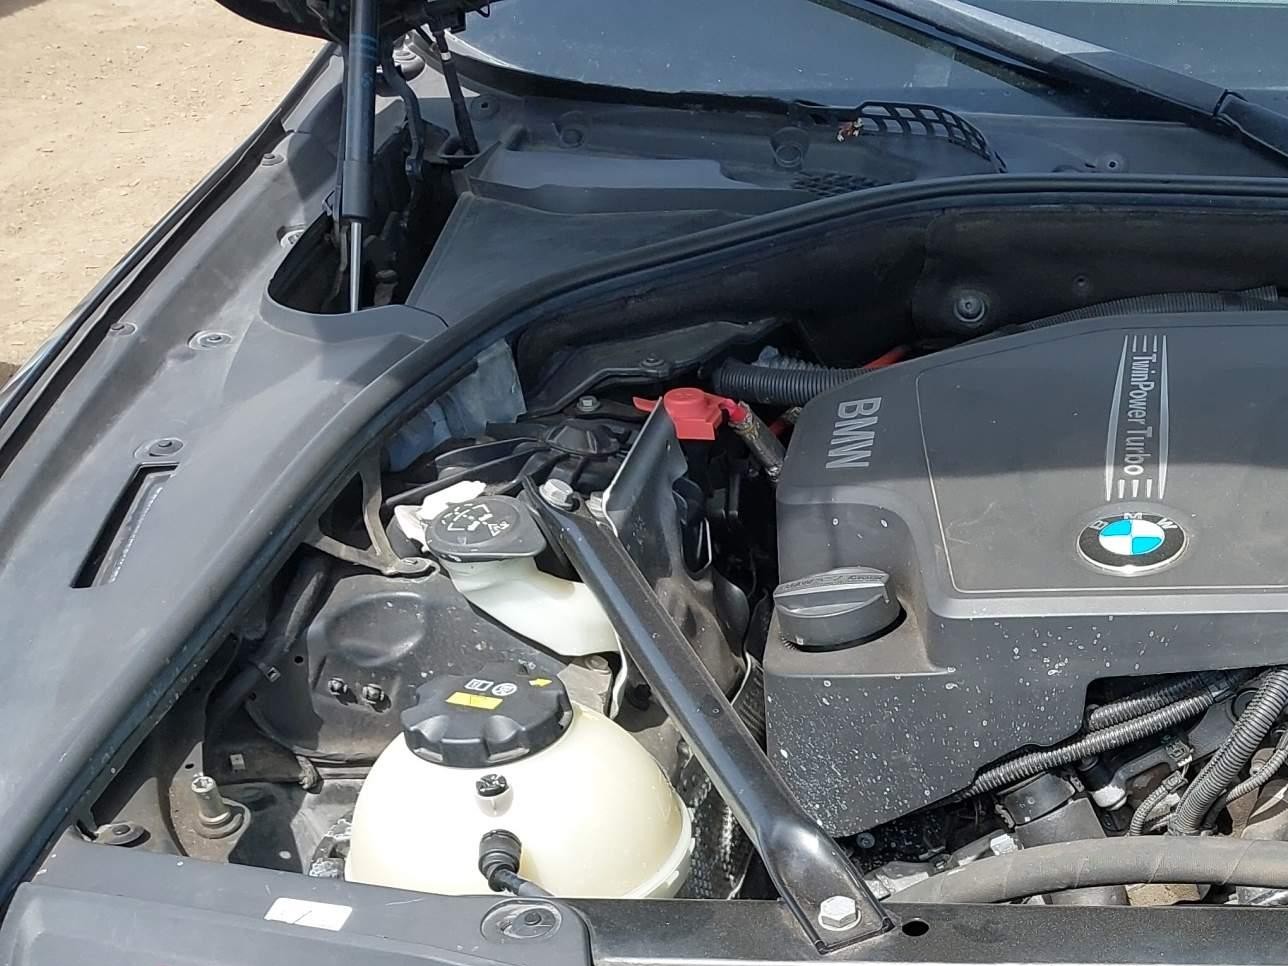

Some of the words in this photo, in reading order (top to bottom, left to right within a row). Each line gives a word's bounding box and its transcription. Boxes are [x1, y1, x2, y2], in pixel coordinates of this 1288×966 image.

[1127, 353, 1157, 424] TwinPower
[826, 396, 882, 469] BMW
[1123, 425, 1153, 475] Turbo
[1089, 512, 1178, 530] BMW
